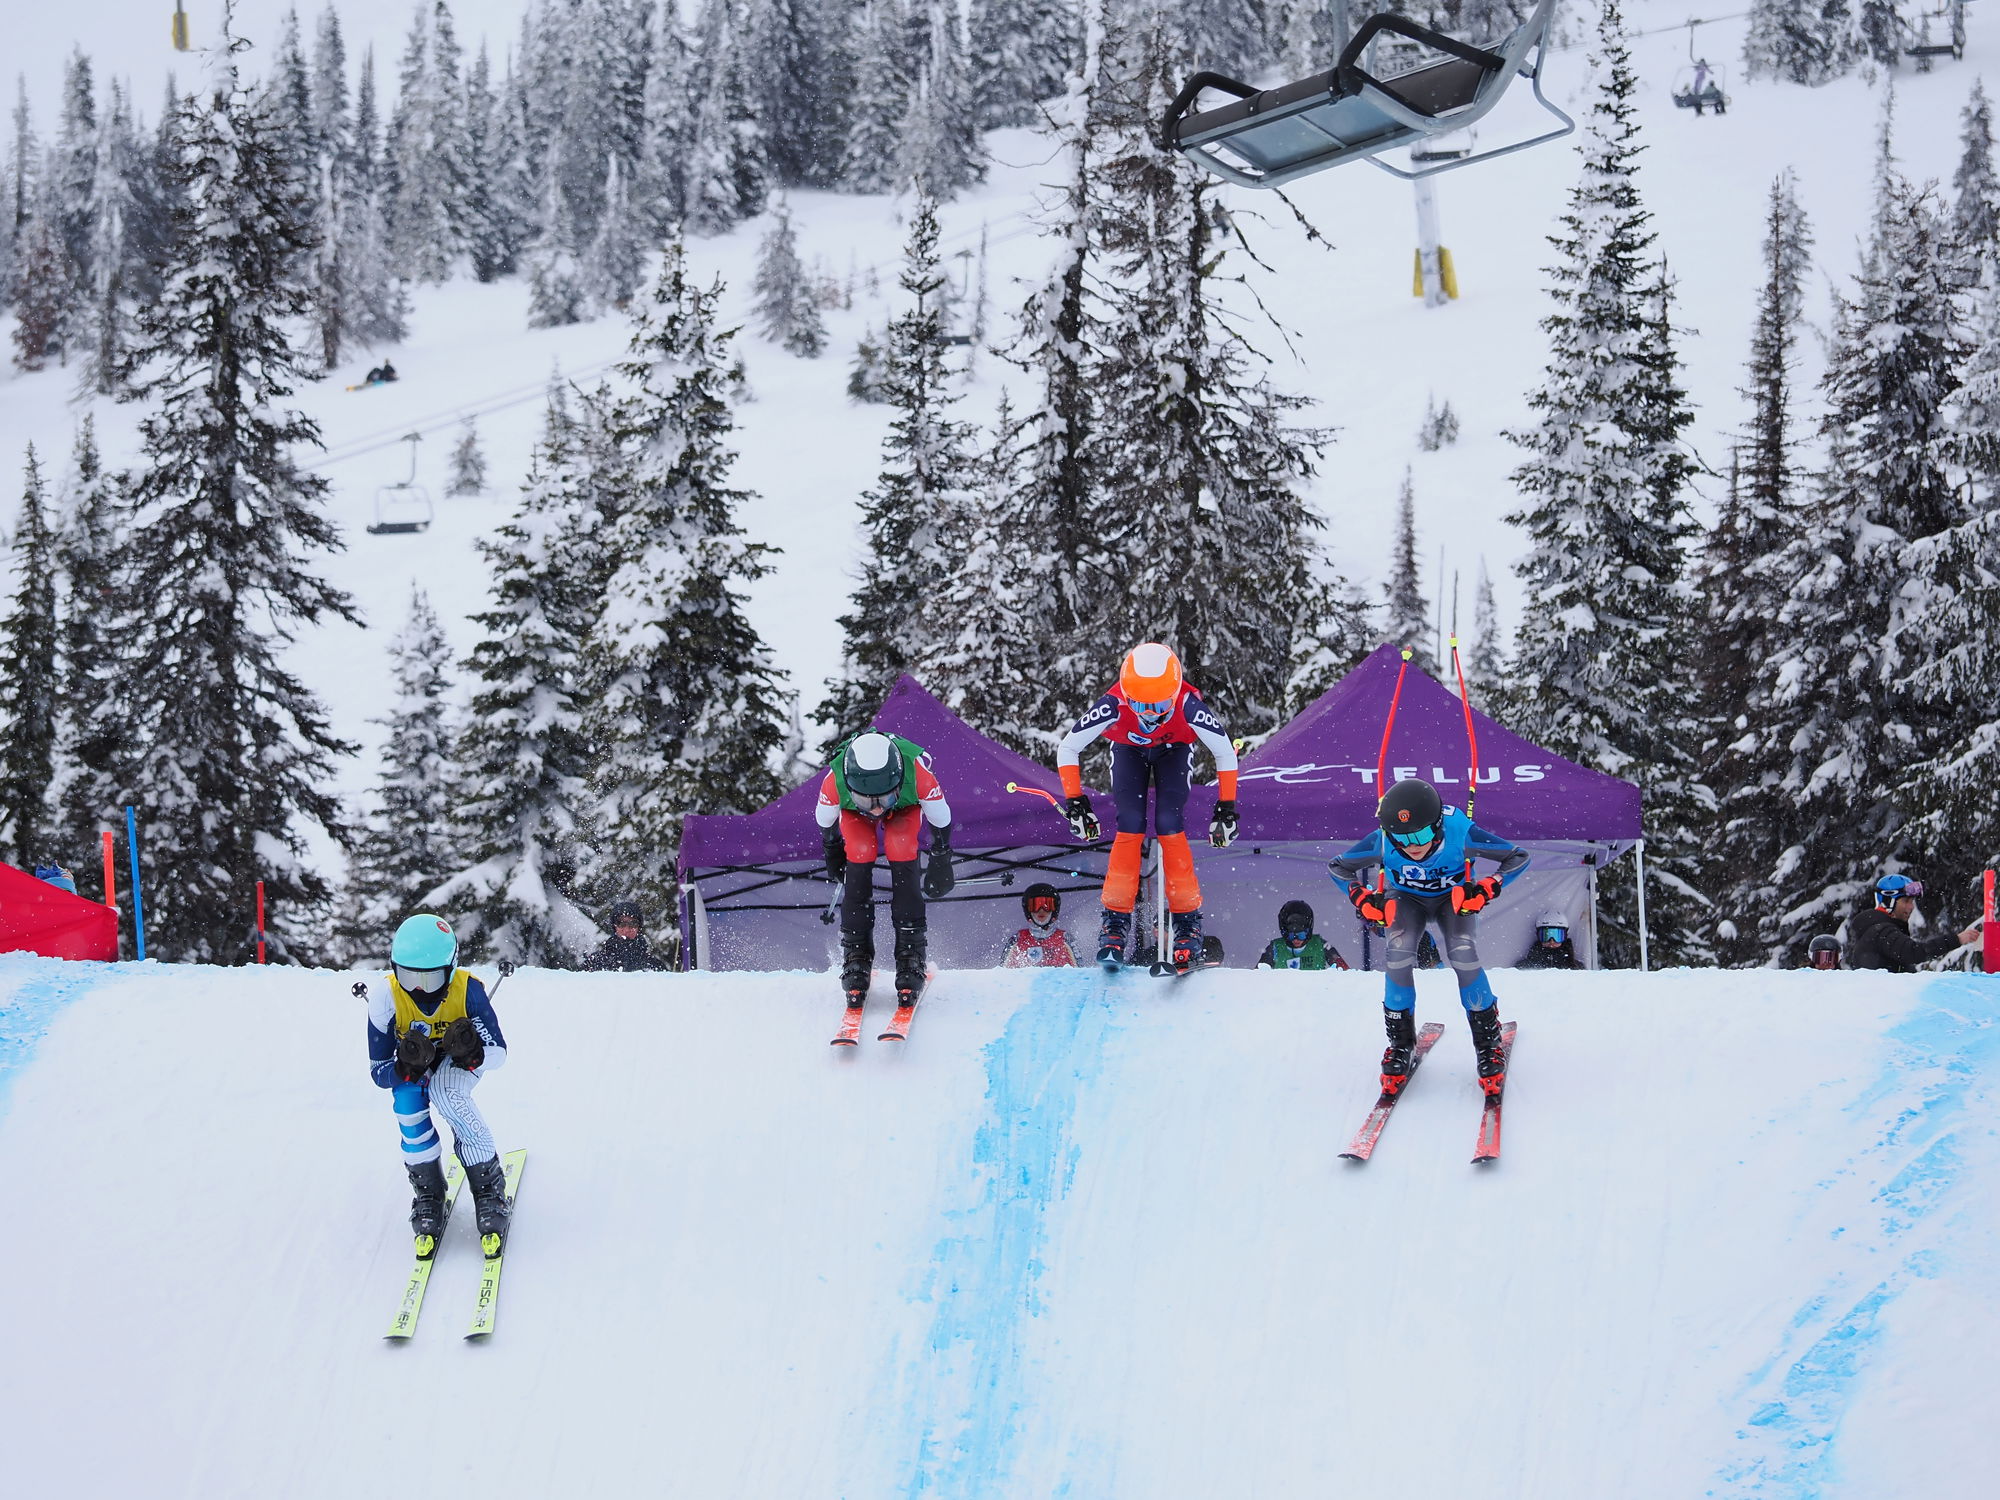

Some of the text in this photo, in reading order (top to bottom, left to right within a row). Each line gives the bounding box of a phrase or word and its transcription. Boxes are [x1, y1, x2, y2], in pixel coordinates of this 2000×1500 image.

[1080, 703, 1112, 728] POC
[1192, 709, 1220, 729] POC
[1351, 764, 1546, 784] TELUS
